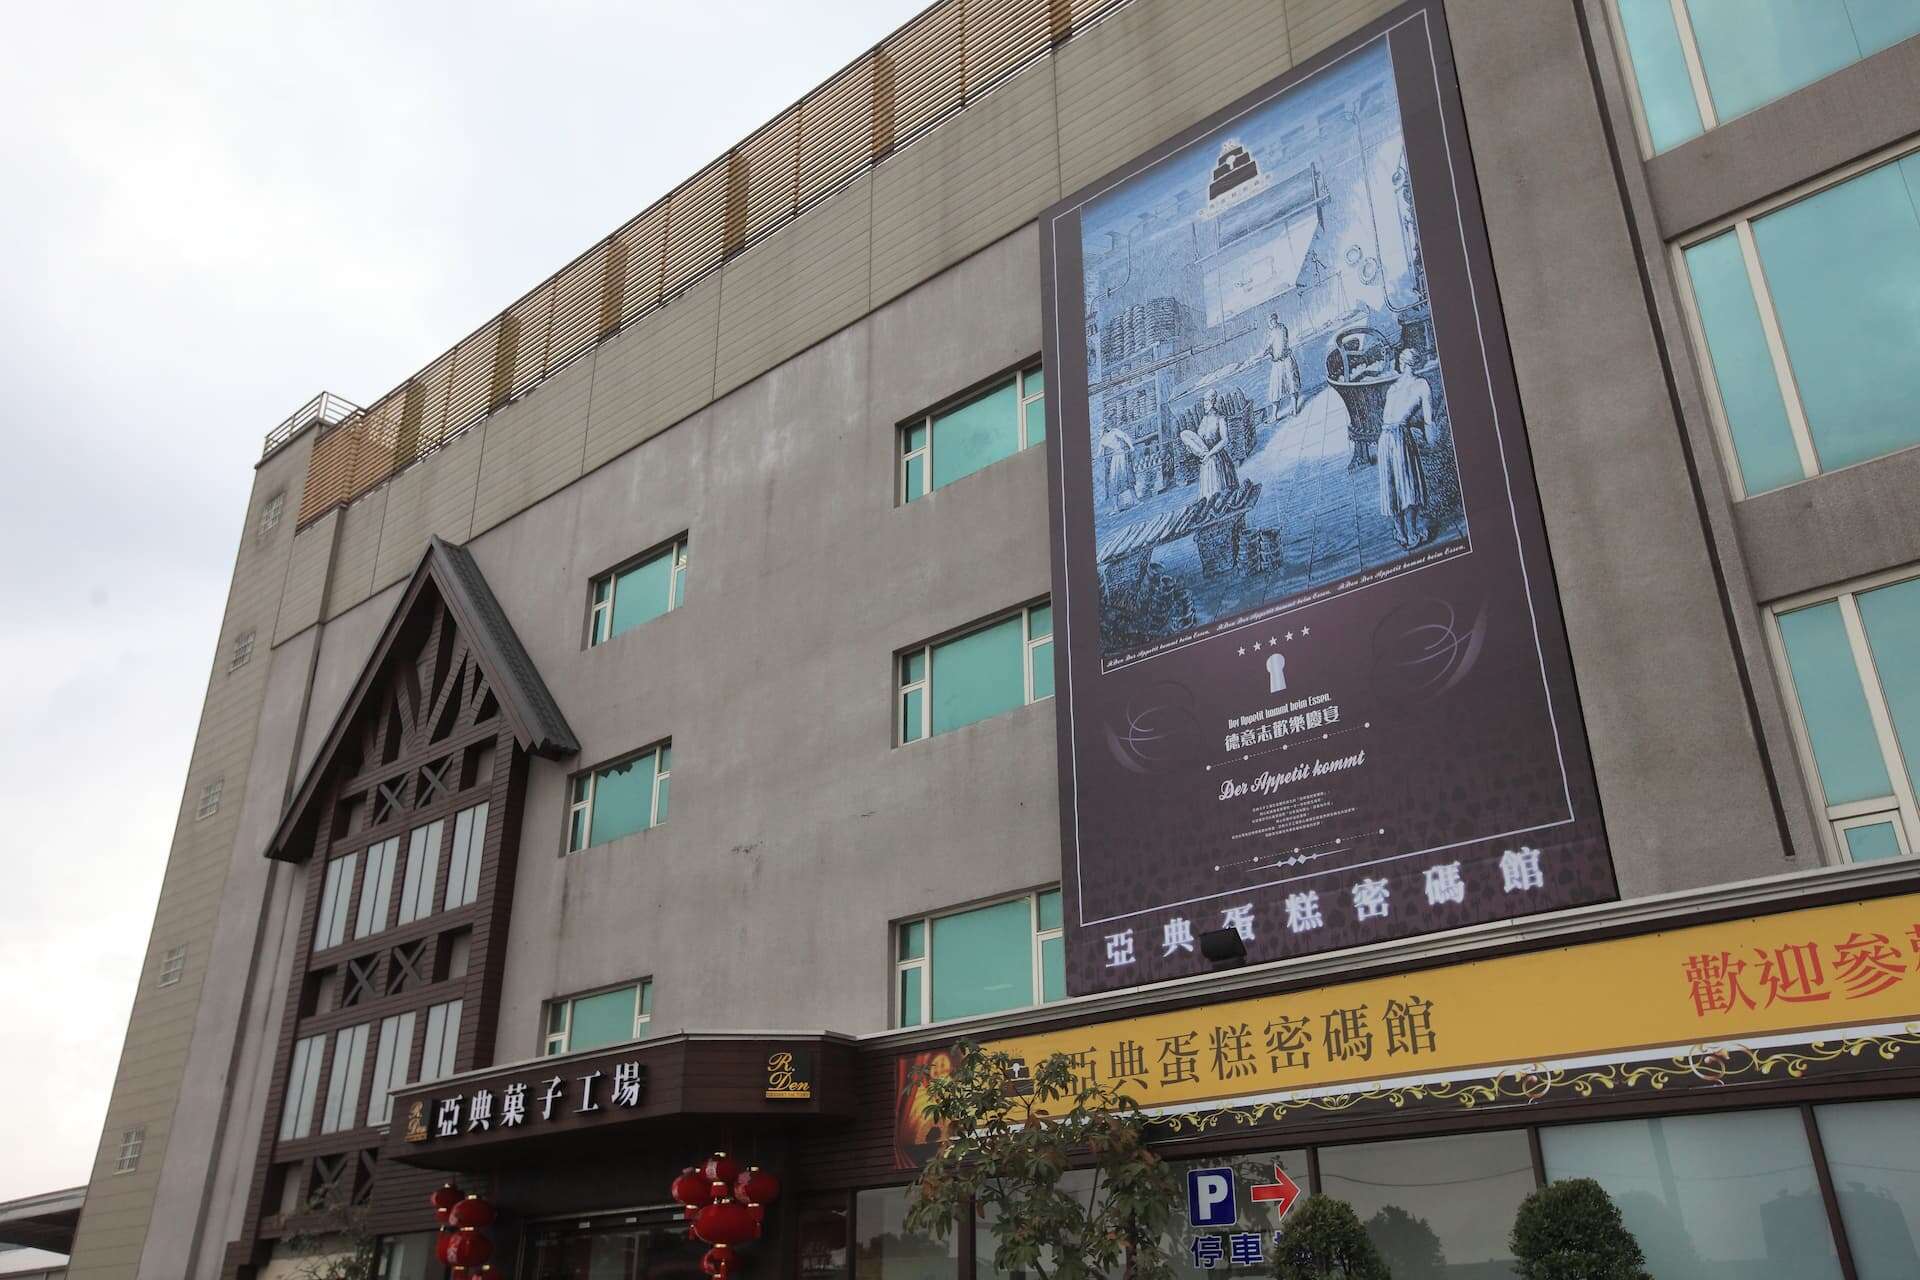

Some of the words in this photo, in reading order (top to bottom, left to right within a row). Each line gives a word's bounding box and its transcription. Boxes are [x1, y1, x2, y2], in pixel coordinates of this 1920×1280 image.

[1218, 778, 1249, 801] Der
[1250, 762, 1310, 795] Appetit
[1311, 749, 1366, 778] kommt
[1682, 923, 1920, 1017] 歡迎參
[768, 1052, 796, 1071] R.
[768, 1071, 810, 1091] Den
[435, 1060, 641, 1137] 亞典菓子工場
[1197, 1174, 1229, 1220] P
[1190, 1231, 1282, 1269] 停車
